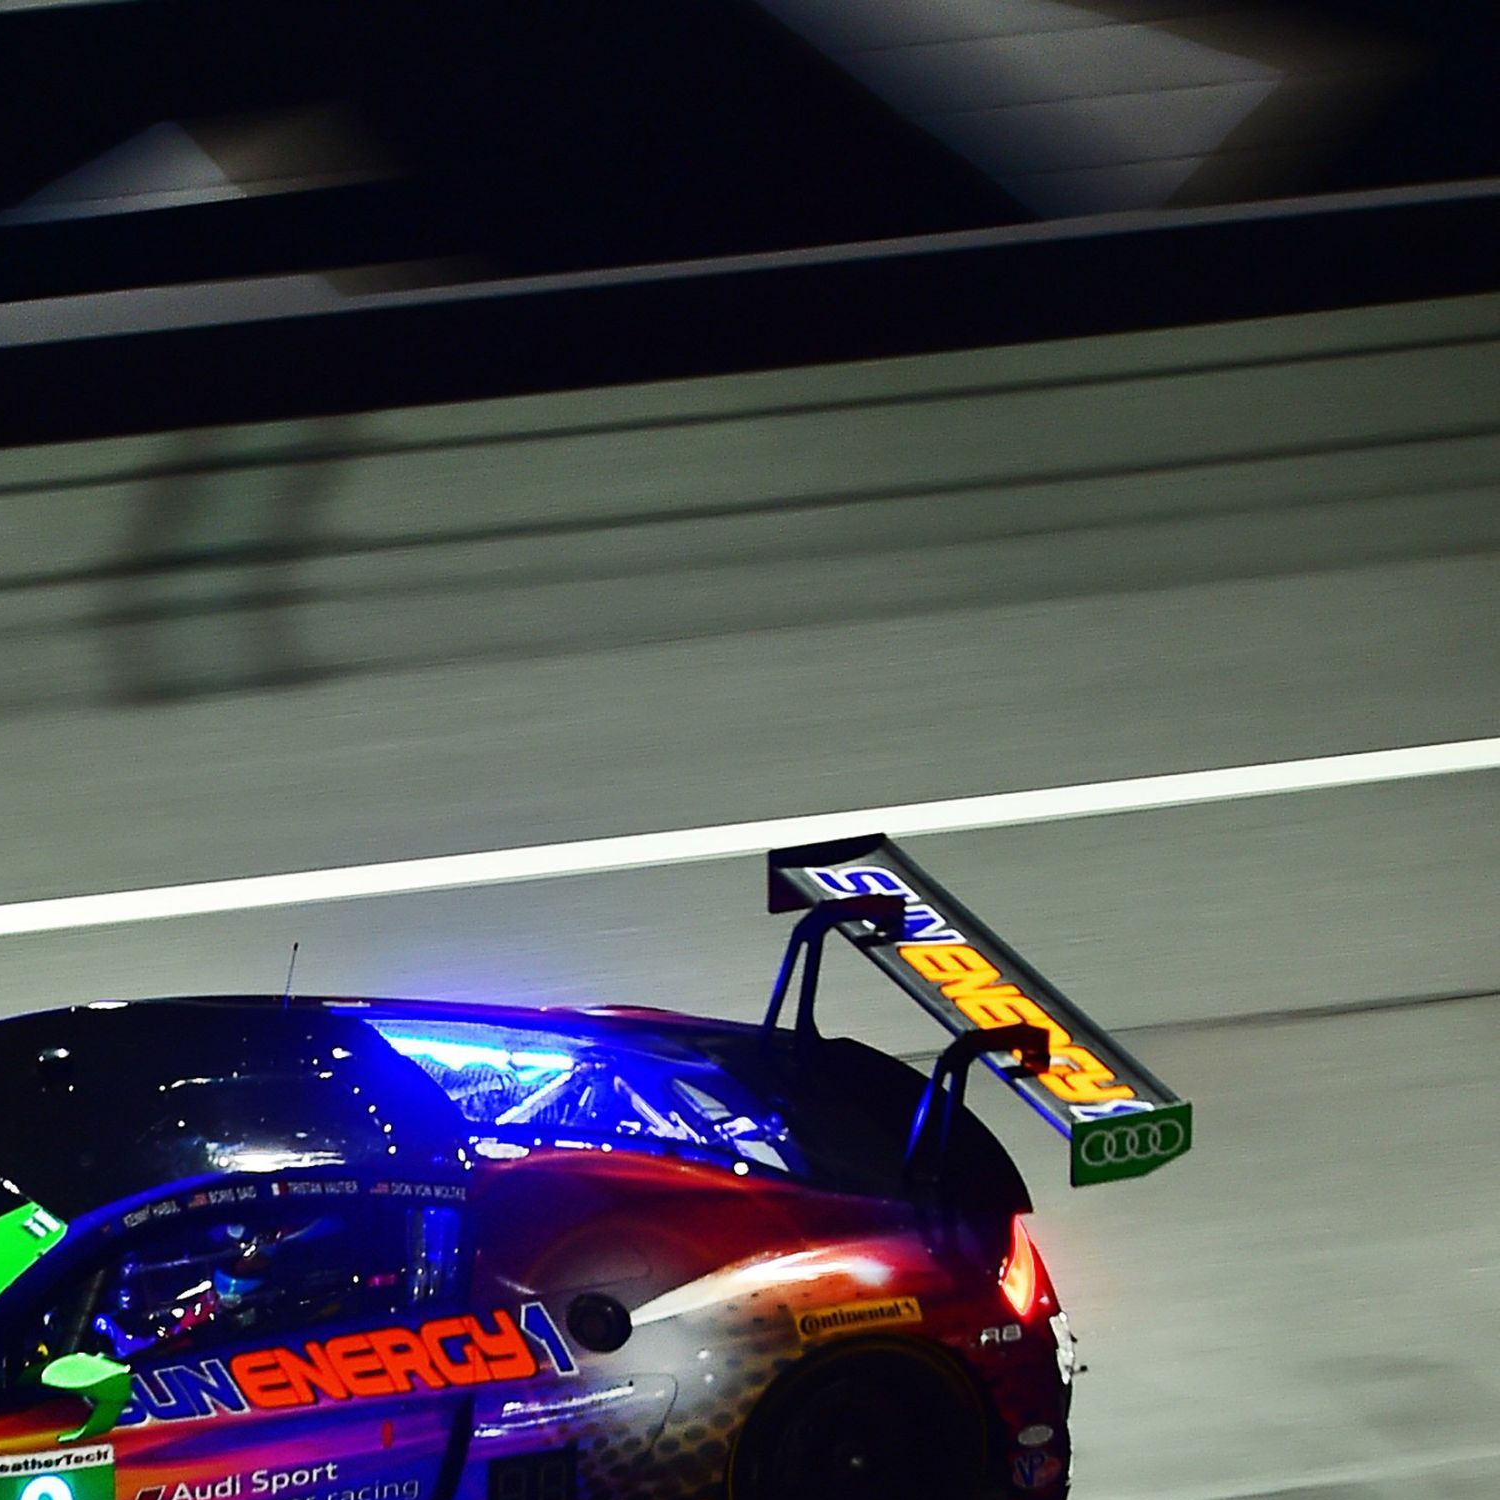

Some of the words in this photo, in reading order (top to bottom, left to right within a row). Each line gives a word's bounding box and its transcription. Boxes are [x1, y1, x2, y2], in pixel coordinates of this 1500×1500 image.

[803, 866, 1155, 1122] SNENEGY1
[799, 1299, 902, 1335] Continental
[252, 1461, 338, 1496] Sport
